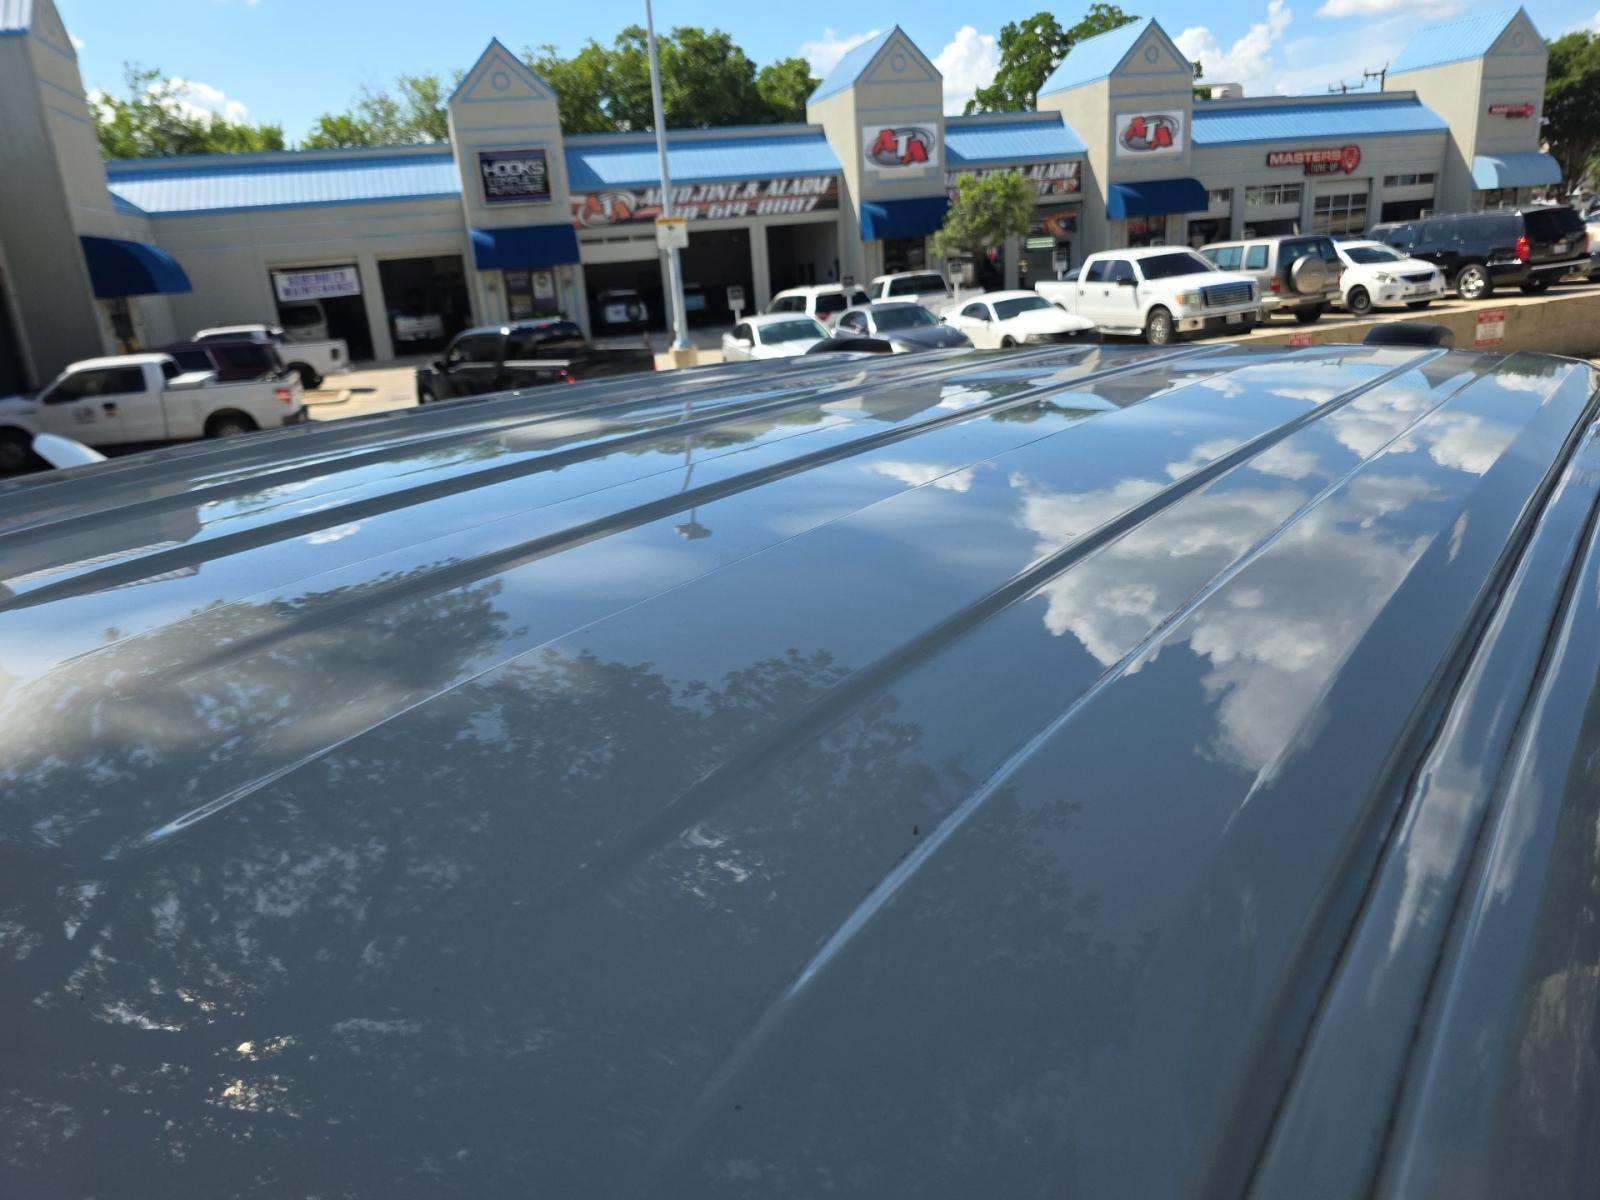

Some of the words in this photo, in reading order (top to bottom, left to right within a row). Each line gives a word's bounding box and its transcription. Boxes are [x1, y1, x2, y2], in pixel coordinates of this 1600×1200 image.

[1125, 115, 1173, 150] ATA
[872, 128, 929, 165] ATA
[1269, 149, 1341, 167] MASTERS
[1029, 163, 1079, 179] ALARM
[766, 176, 832, 196] ALARM
